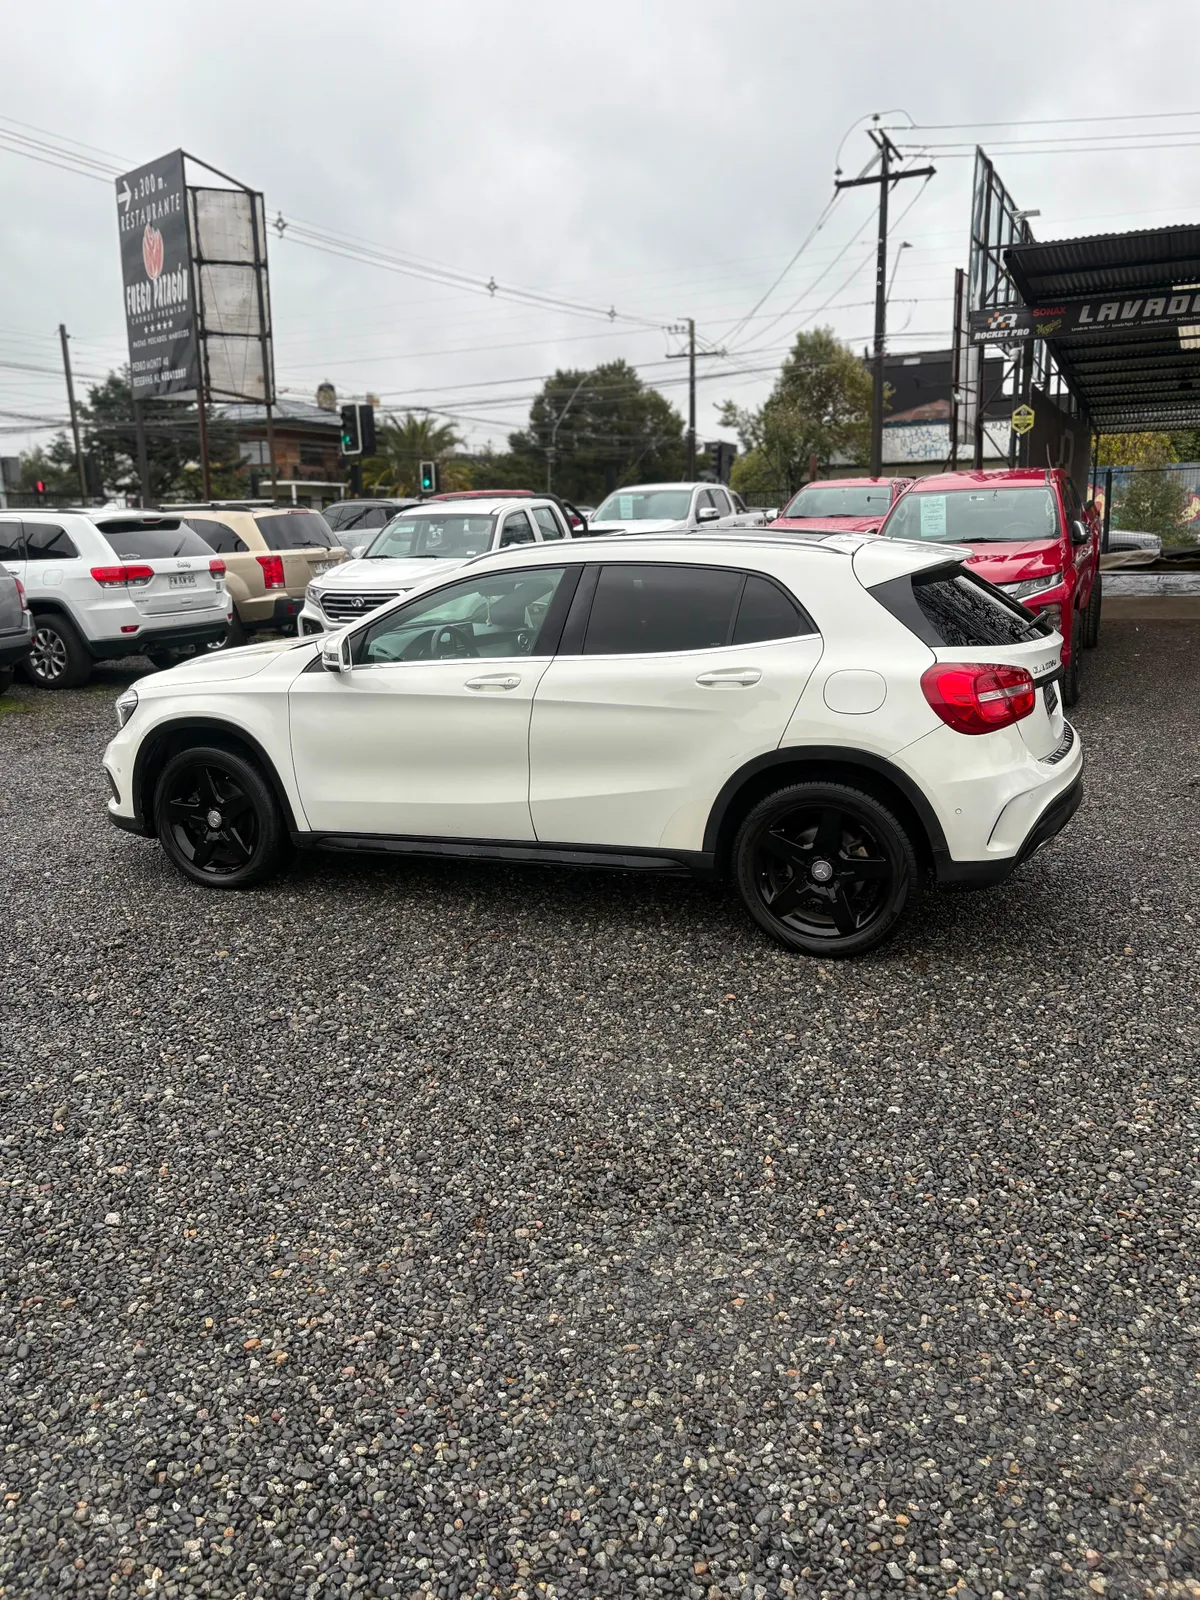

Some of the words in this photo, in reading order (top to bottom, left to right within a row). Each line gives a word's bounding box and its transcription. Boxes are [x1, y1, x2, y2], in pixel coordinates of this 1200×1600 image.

[134, 187, 139, 200] a
[140, 173, 156, 197] 300
[120, 192, 180, 232] RESTAURANTE
[126, 280, 151, 316] FUEGO
[153, 262, 188, 309] PATAGÓN
[131, 312, 154, 325] CARNES
[157, 304, 186, 319] PREMIUM
[1033, 306, 1066, 317] SONAX
[147, 334, 168, 345] PESCADOS
[168, 329, 190, 341] MARISCOS
[974, 330, 1010, 340] ROCKET
[1010, 328, 1030, 338] PRO
